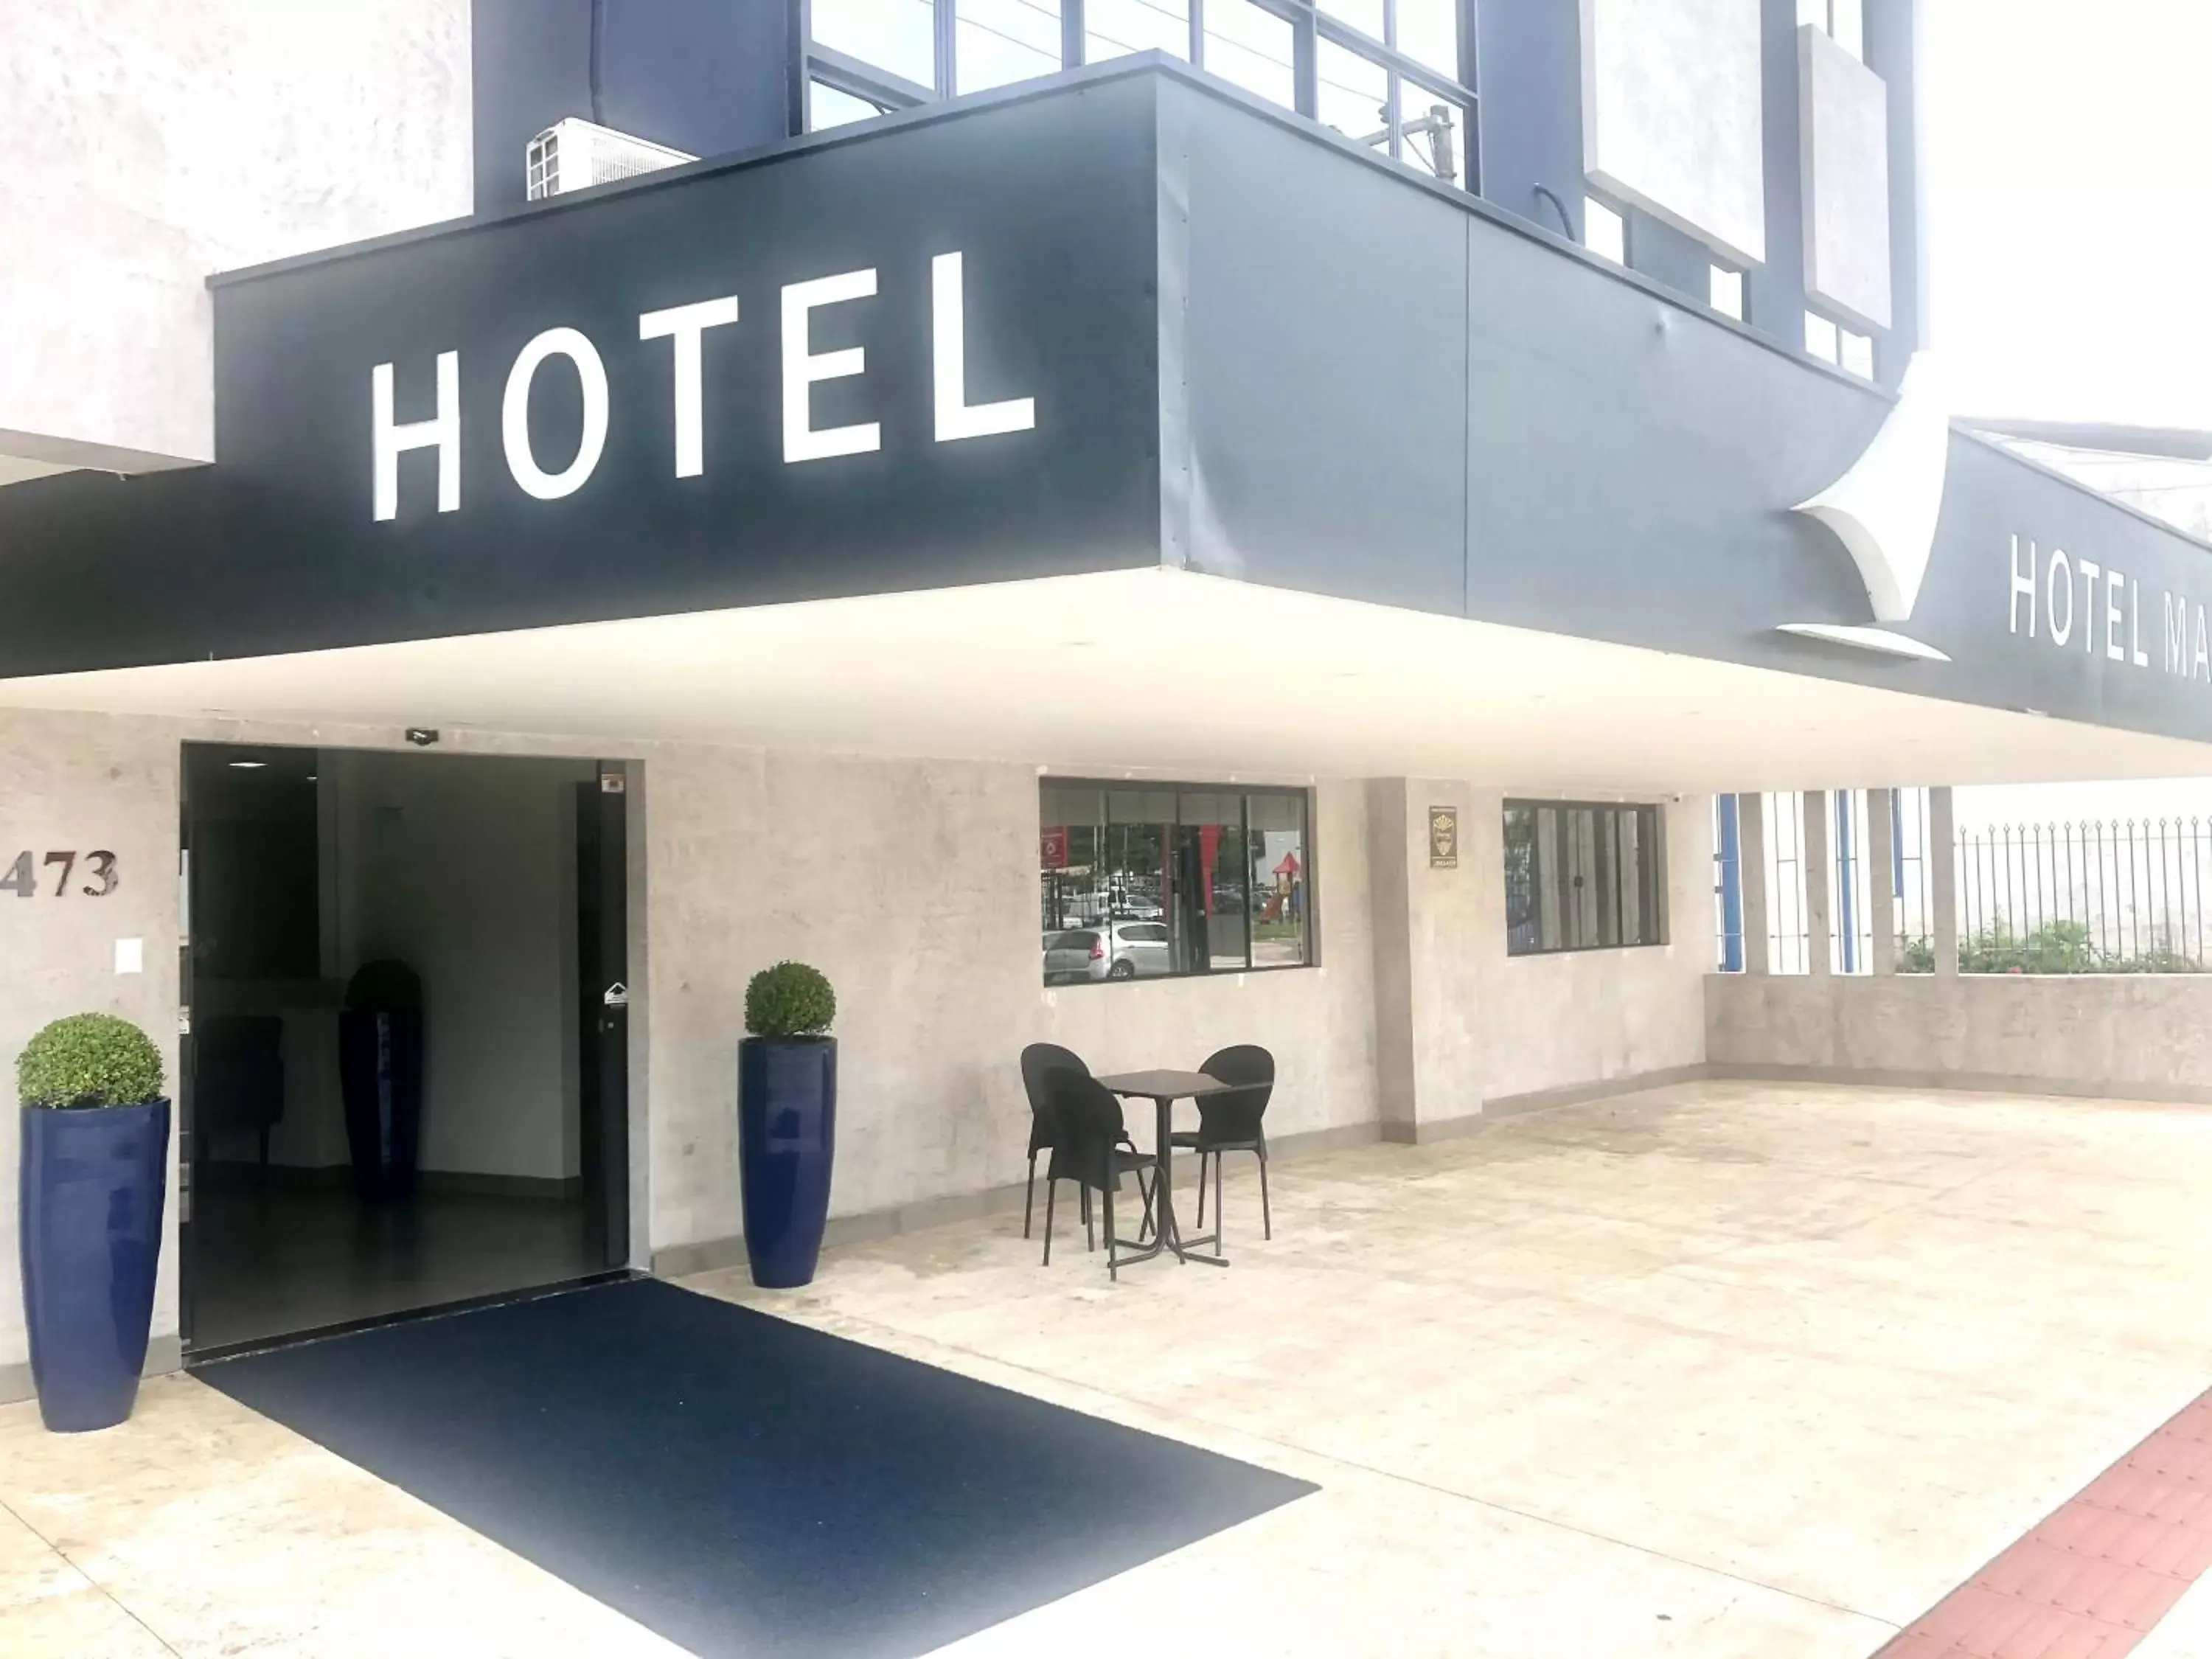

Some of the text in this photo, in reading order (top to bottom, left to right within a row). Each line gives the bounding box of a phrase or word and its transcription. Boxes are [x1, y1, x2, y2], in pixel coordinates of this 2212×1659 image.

[372, 251, 1035, 521] HOTEL
[2010, 534, 2212, 683] HOTEL MA
[0, 850, 118, 897] 473
